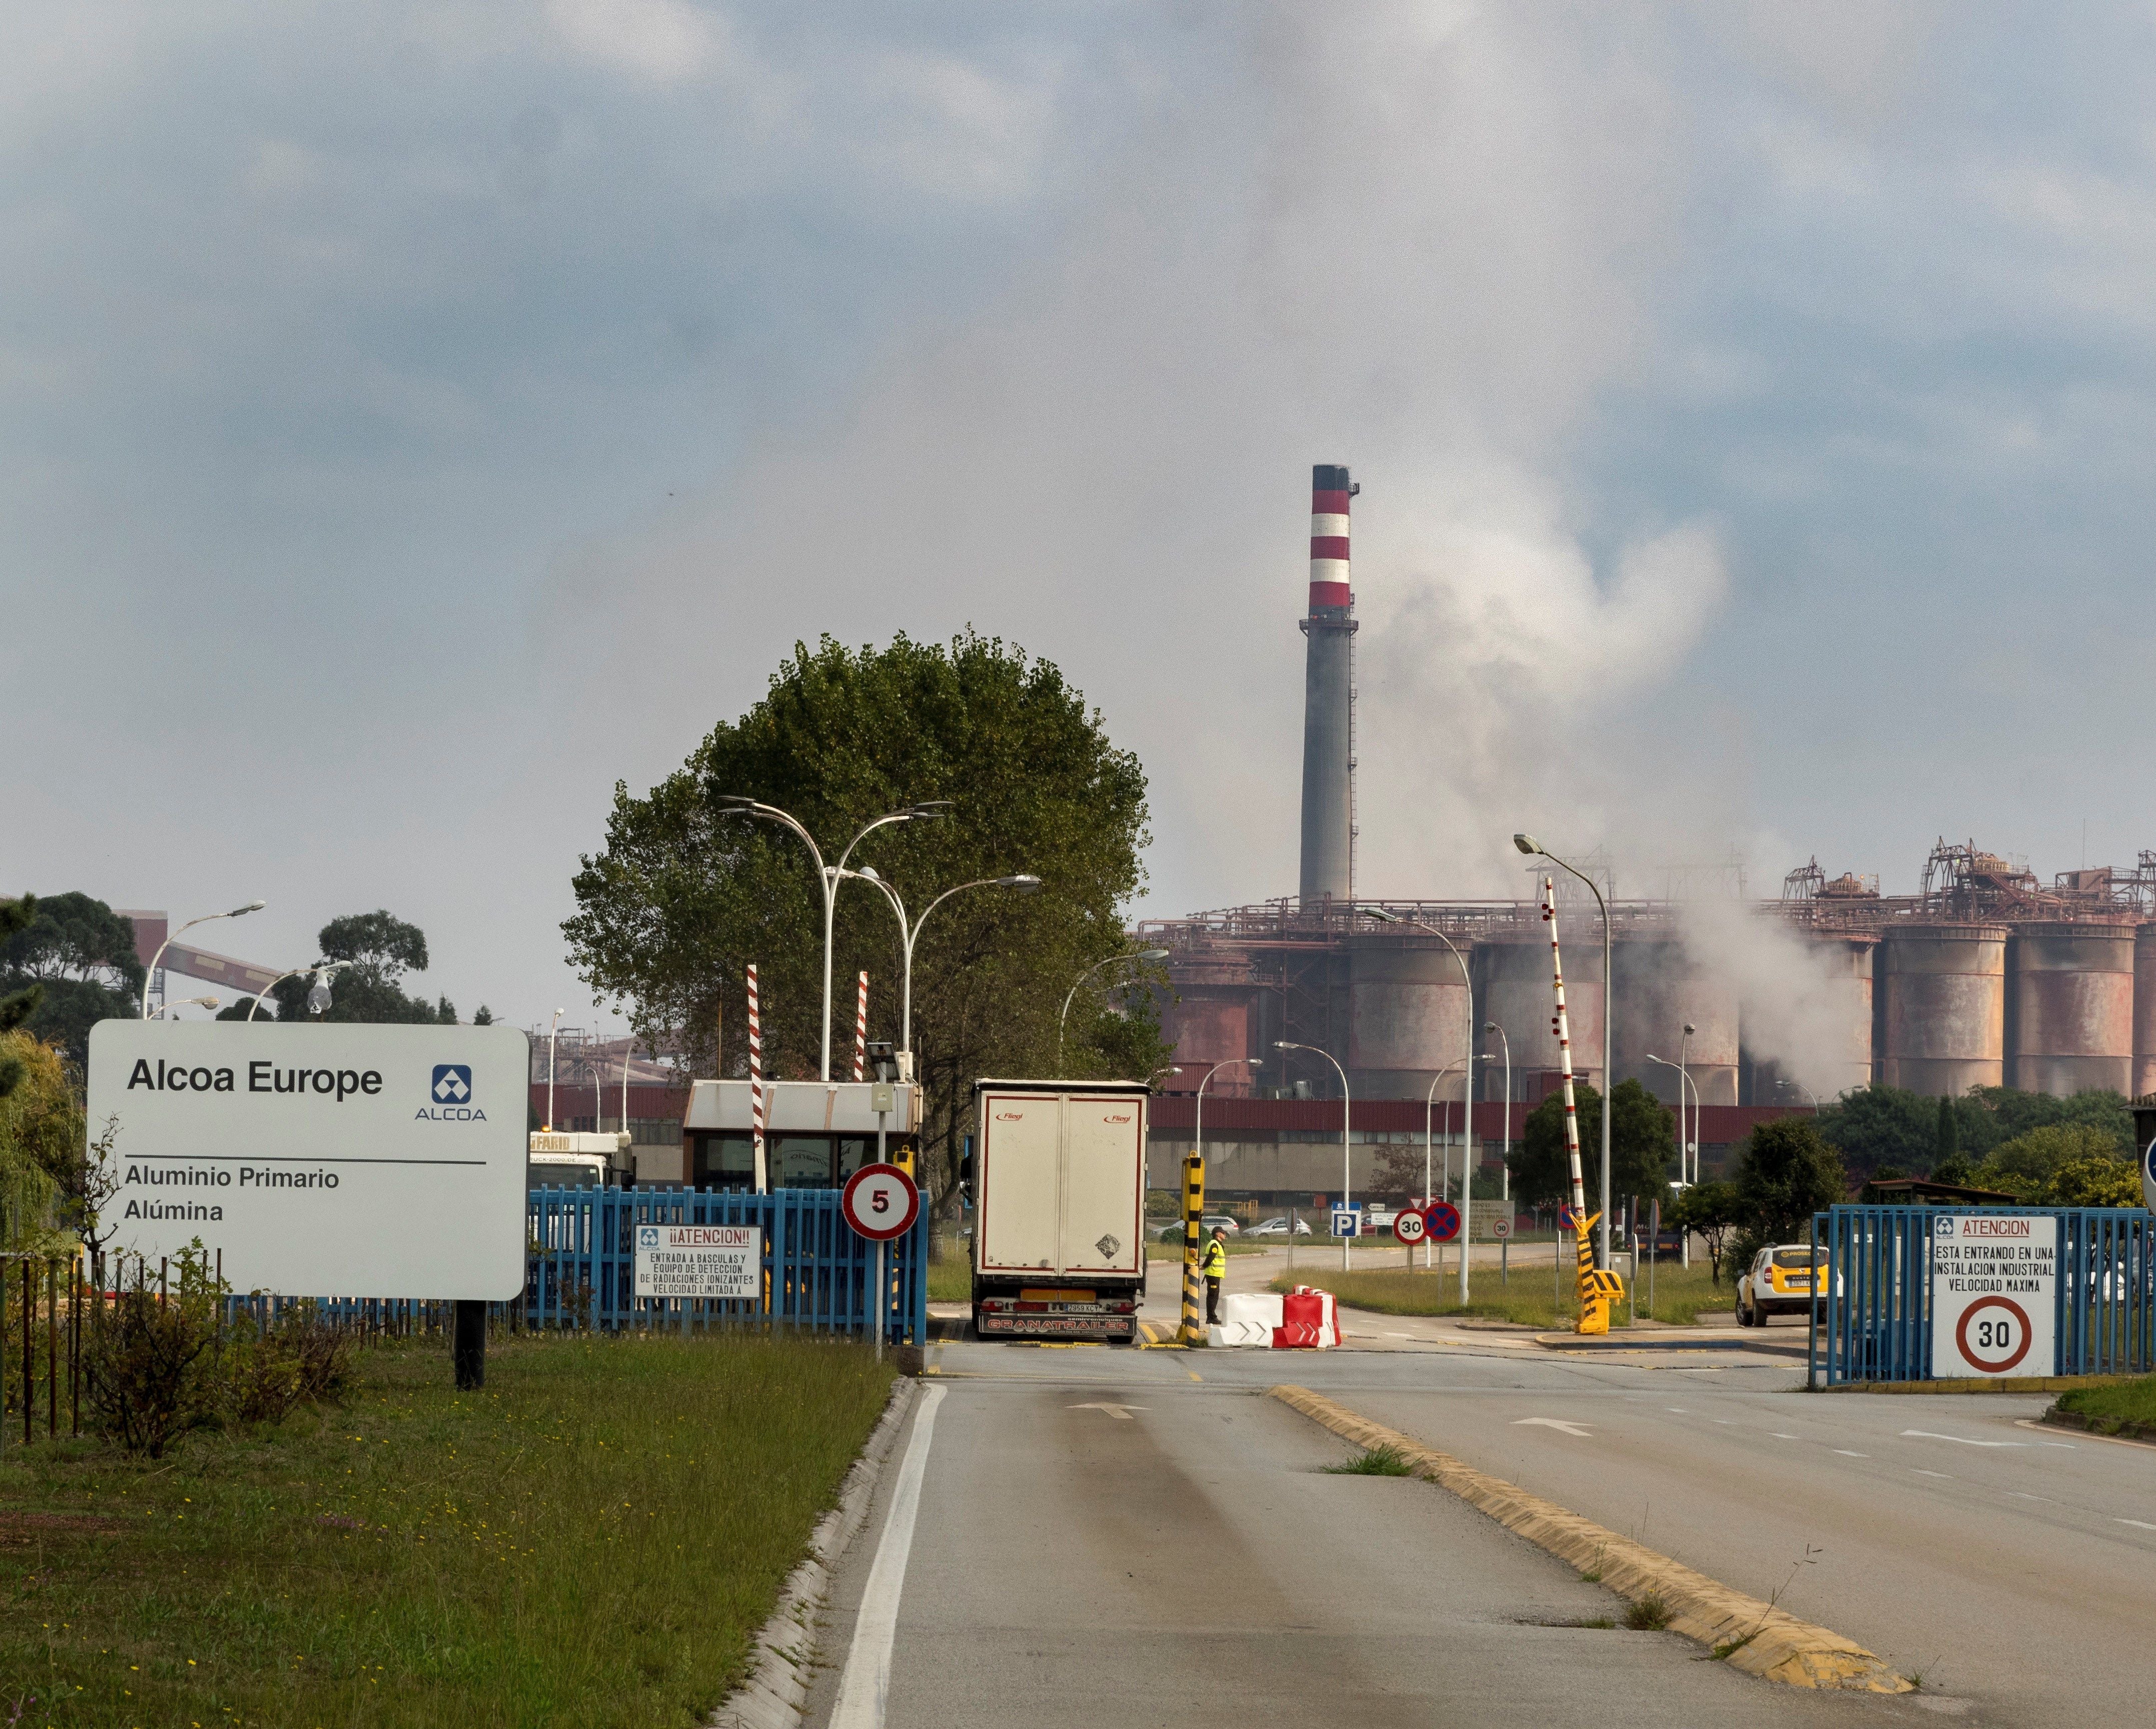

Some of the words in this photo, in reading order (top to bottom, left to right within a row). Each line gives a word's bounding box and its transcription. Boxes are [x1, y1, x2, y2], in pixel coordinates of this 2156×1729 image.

[128, 1059, 234, 1091] Alcoa
[249, 1062, 382, 1102] Europe
[415, 1108, 486, 1121] ALCOA
[125, 1165, 231, 1186] Aluminio
[240, 1168, 339, 1188] Primario
[872, 1190, 889, 1213] 5
[125, 1200, 222, 1220] Alúmina
[1337, 1216, 1352, 1235] P
[1402, 1221, 1420, 1233] 30
[1963, 1220, 2029, 1234] ATENCION
[670, 1229, 749, 1244] ¡¡ATENCION!!
[651, 1253, 685, 1262] ENTRADA
[690, 1254, 693, 1262] A
[697, 1254, 738, 1263] BASCULAS
[741, 1255, 746, 1263] Y
[1936, 1246, 1959, 1258] ESTA
[1964, 1247, 2014, 1259] ENTRANDO
[2019, 1247, 2030, 1259] EN
[2035, 1248, 2053, 1259] UNA
[654, 1264, 682, 1273] EQUIPO
[686, 1264, 695, 1273] DE
[699, 1264, 742, 1274] DETECCION
[1935, 1263, 1995, 1275] INSTALACION
[1999, 1264, 2054, 1276] INDUSTRIAL
[640, 1274, 649, 1283] DE
[653, 1274, 703, 1283] RADIACIONES
[707, 1275, 753, 1284] IONIZANTES
[1949, 1279, 2001, 1291] VELOCIDAD
[2007, 1280, 2039, 1292] MAXIMA
[653, 1284, 696, 1293] VELOCIDAD
[700, 1285, 733, 1294] LIMITADA
[738, 1286, 741, 1294] A
[988, 1319, 1128, 1330] GRANATRAILER
[1979, 1322, 2009, 1347] 30
